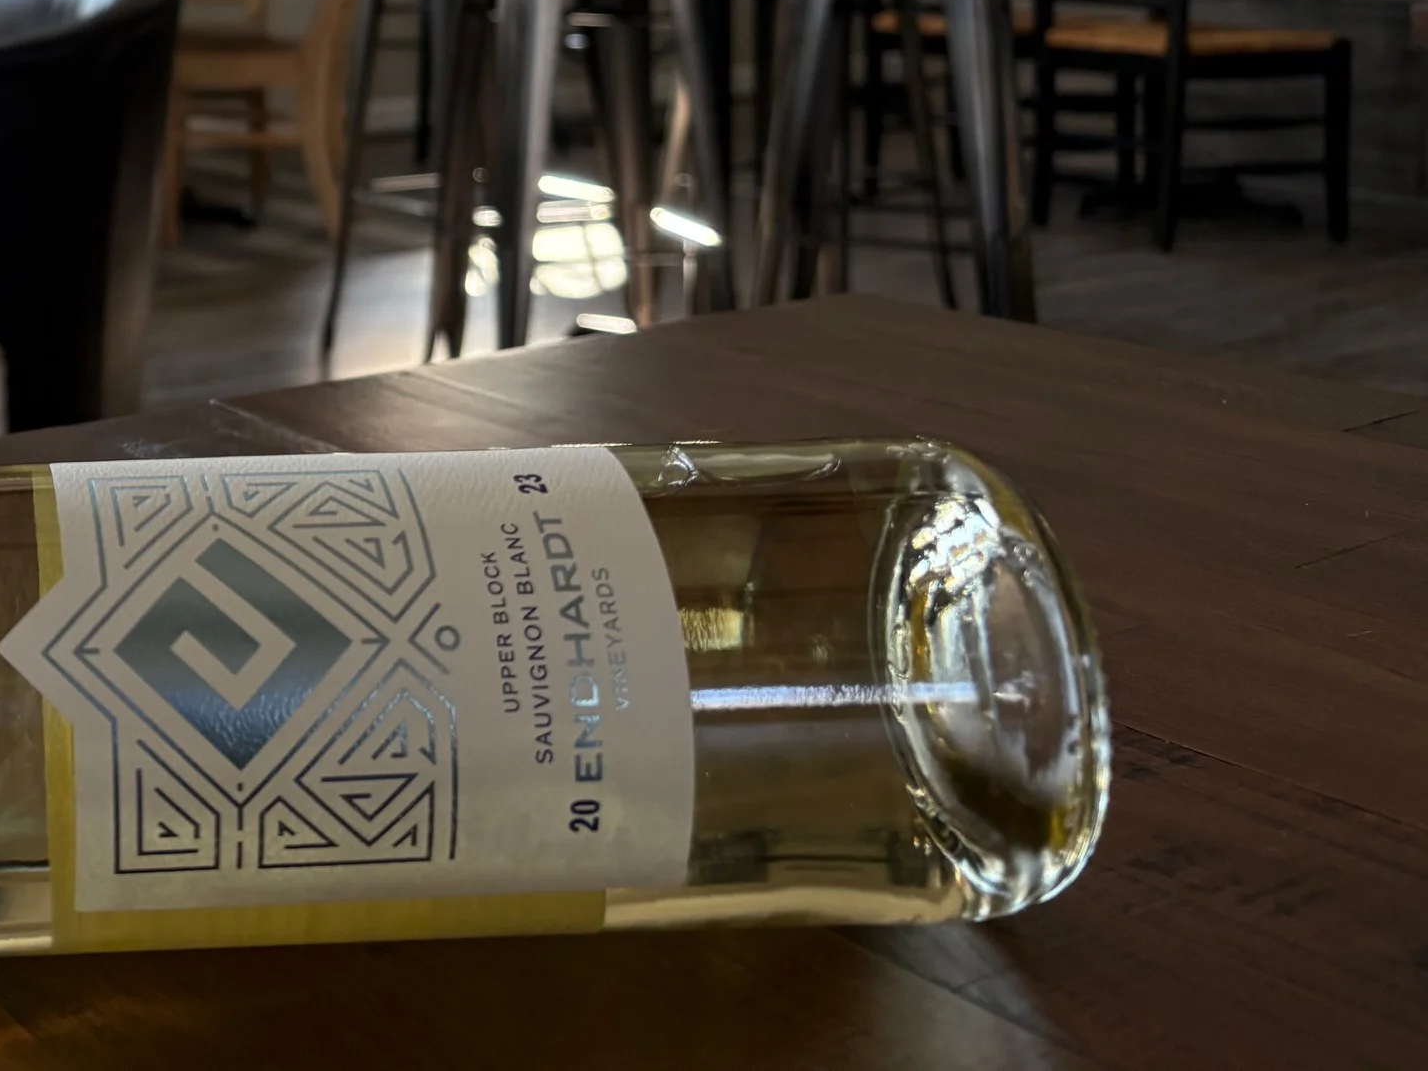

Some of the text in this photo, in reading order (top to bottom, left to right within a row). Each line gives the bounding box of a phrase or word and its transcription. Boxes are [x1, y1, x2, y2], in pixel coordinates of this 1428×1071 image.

[480, 551, 520, 713] UPPER BLOCK
[500, 522, 554, 765] SAUVIGNON BLANC
[513, 473, 605, 833] 20 ENDHARDT 23
[591, 566, 632, 711] VINEYARDS
